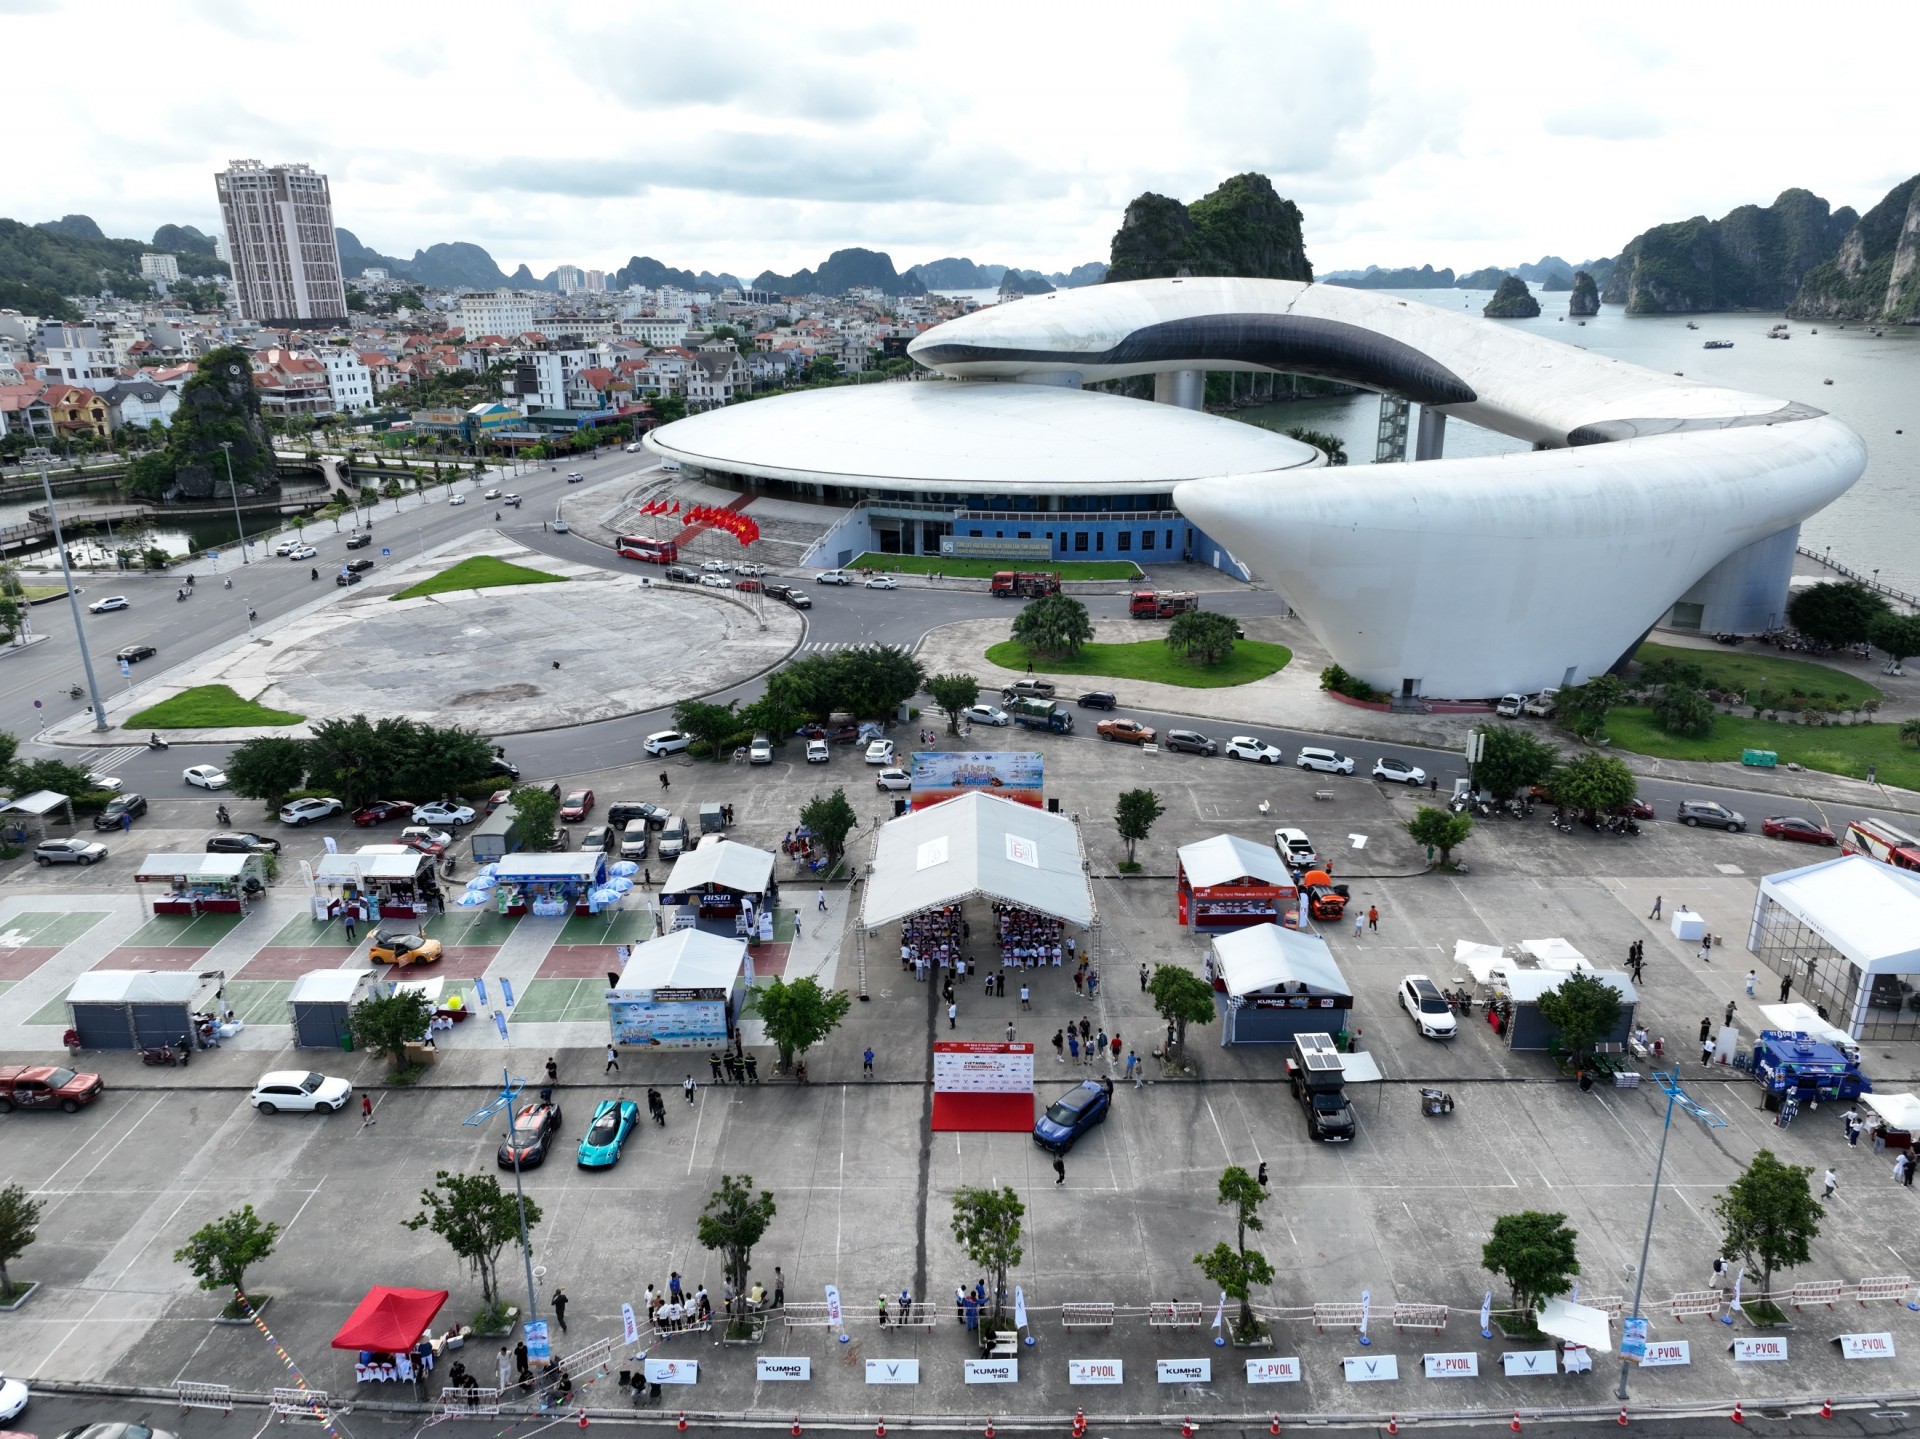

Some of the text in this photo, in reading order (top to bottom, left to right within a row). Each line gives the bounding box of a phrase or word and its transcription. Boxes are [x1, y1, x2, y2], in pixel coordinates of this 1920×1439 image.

[1755, 1343, 1778, 1354] PVOIL
[1862, 1338, 1886, 1350] PVOIL
[1658, 1347, 1682, 1359] PVOIL
[1268, 1364, 1292, 1375] PVOIL
[1446, 1358, 1471, 1370] PVOIL
[1090, 1366, 1115, 1377] PVOIL
